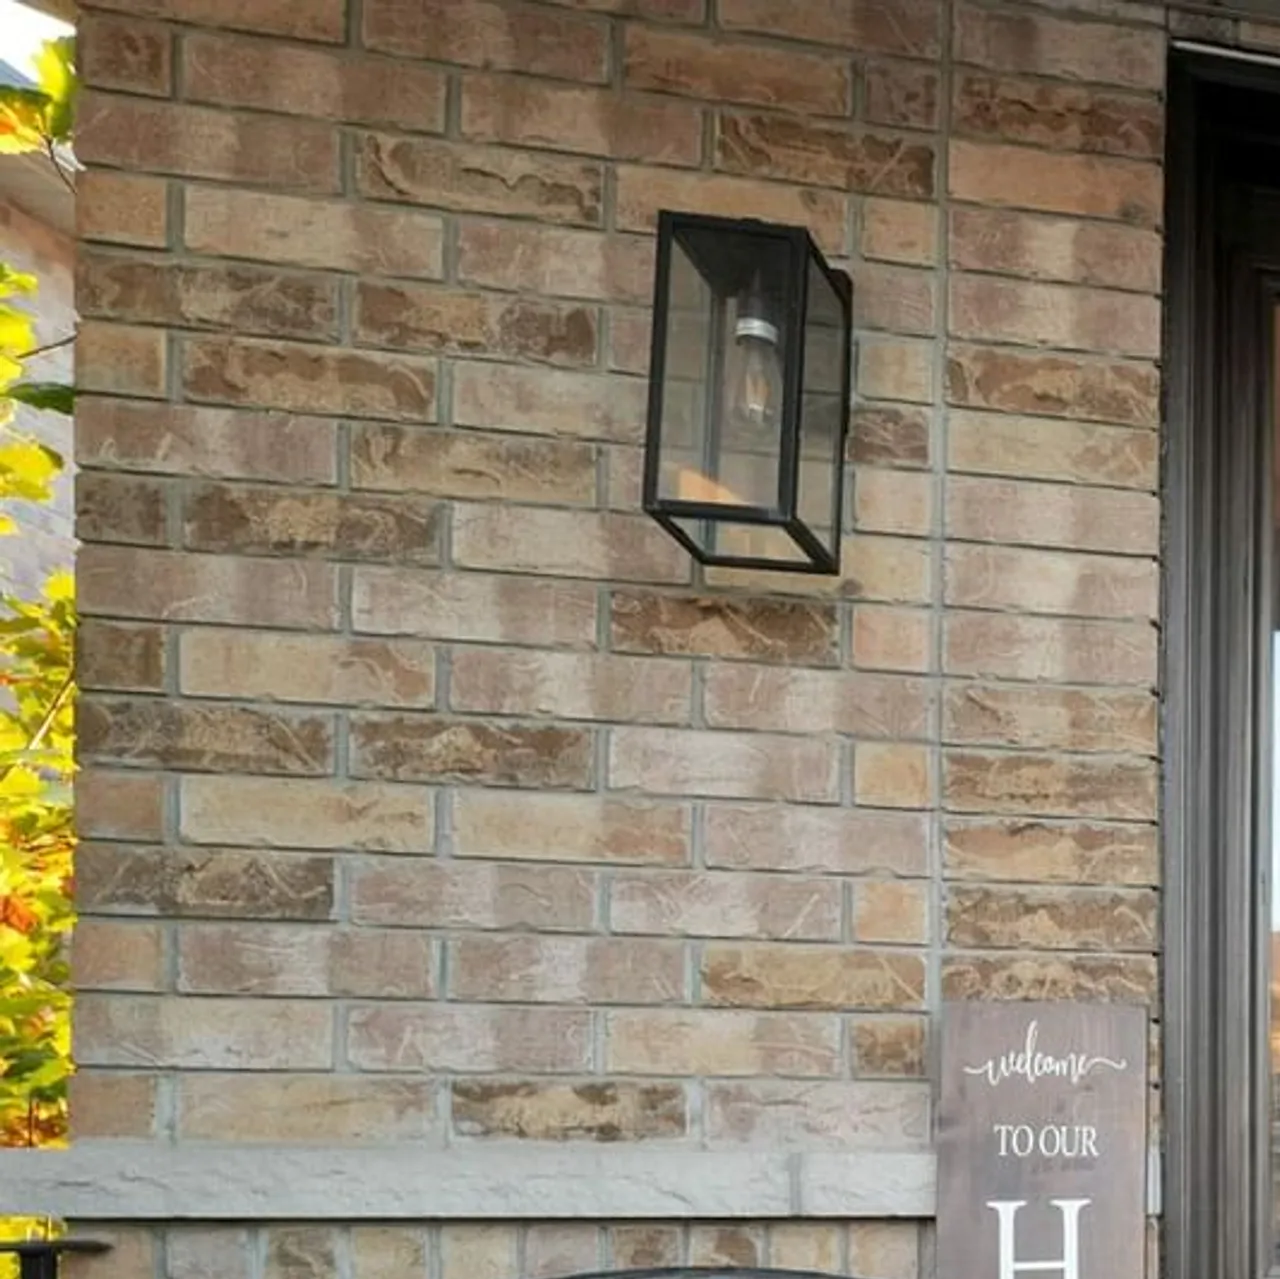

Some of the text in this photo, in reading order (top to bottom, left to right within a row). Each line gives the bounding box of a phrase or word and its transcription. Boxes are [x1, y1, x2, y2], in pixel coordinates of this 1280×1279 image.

[964, 1020, 1127, 1085] welcome
[994, 1124, 1099, 1157] TO OUR
